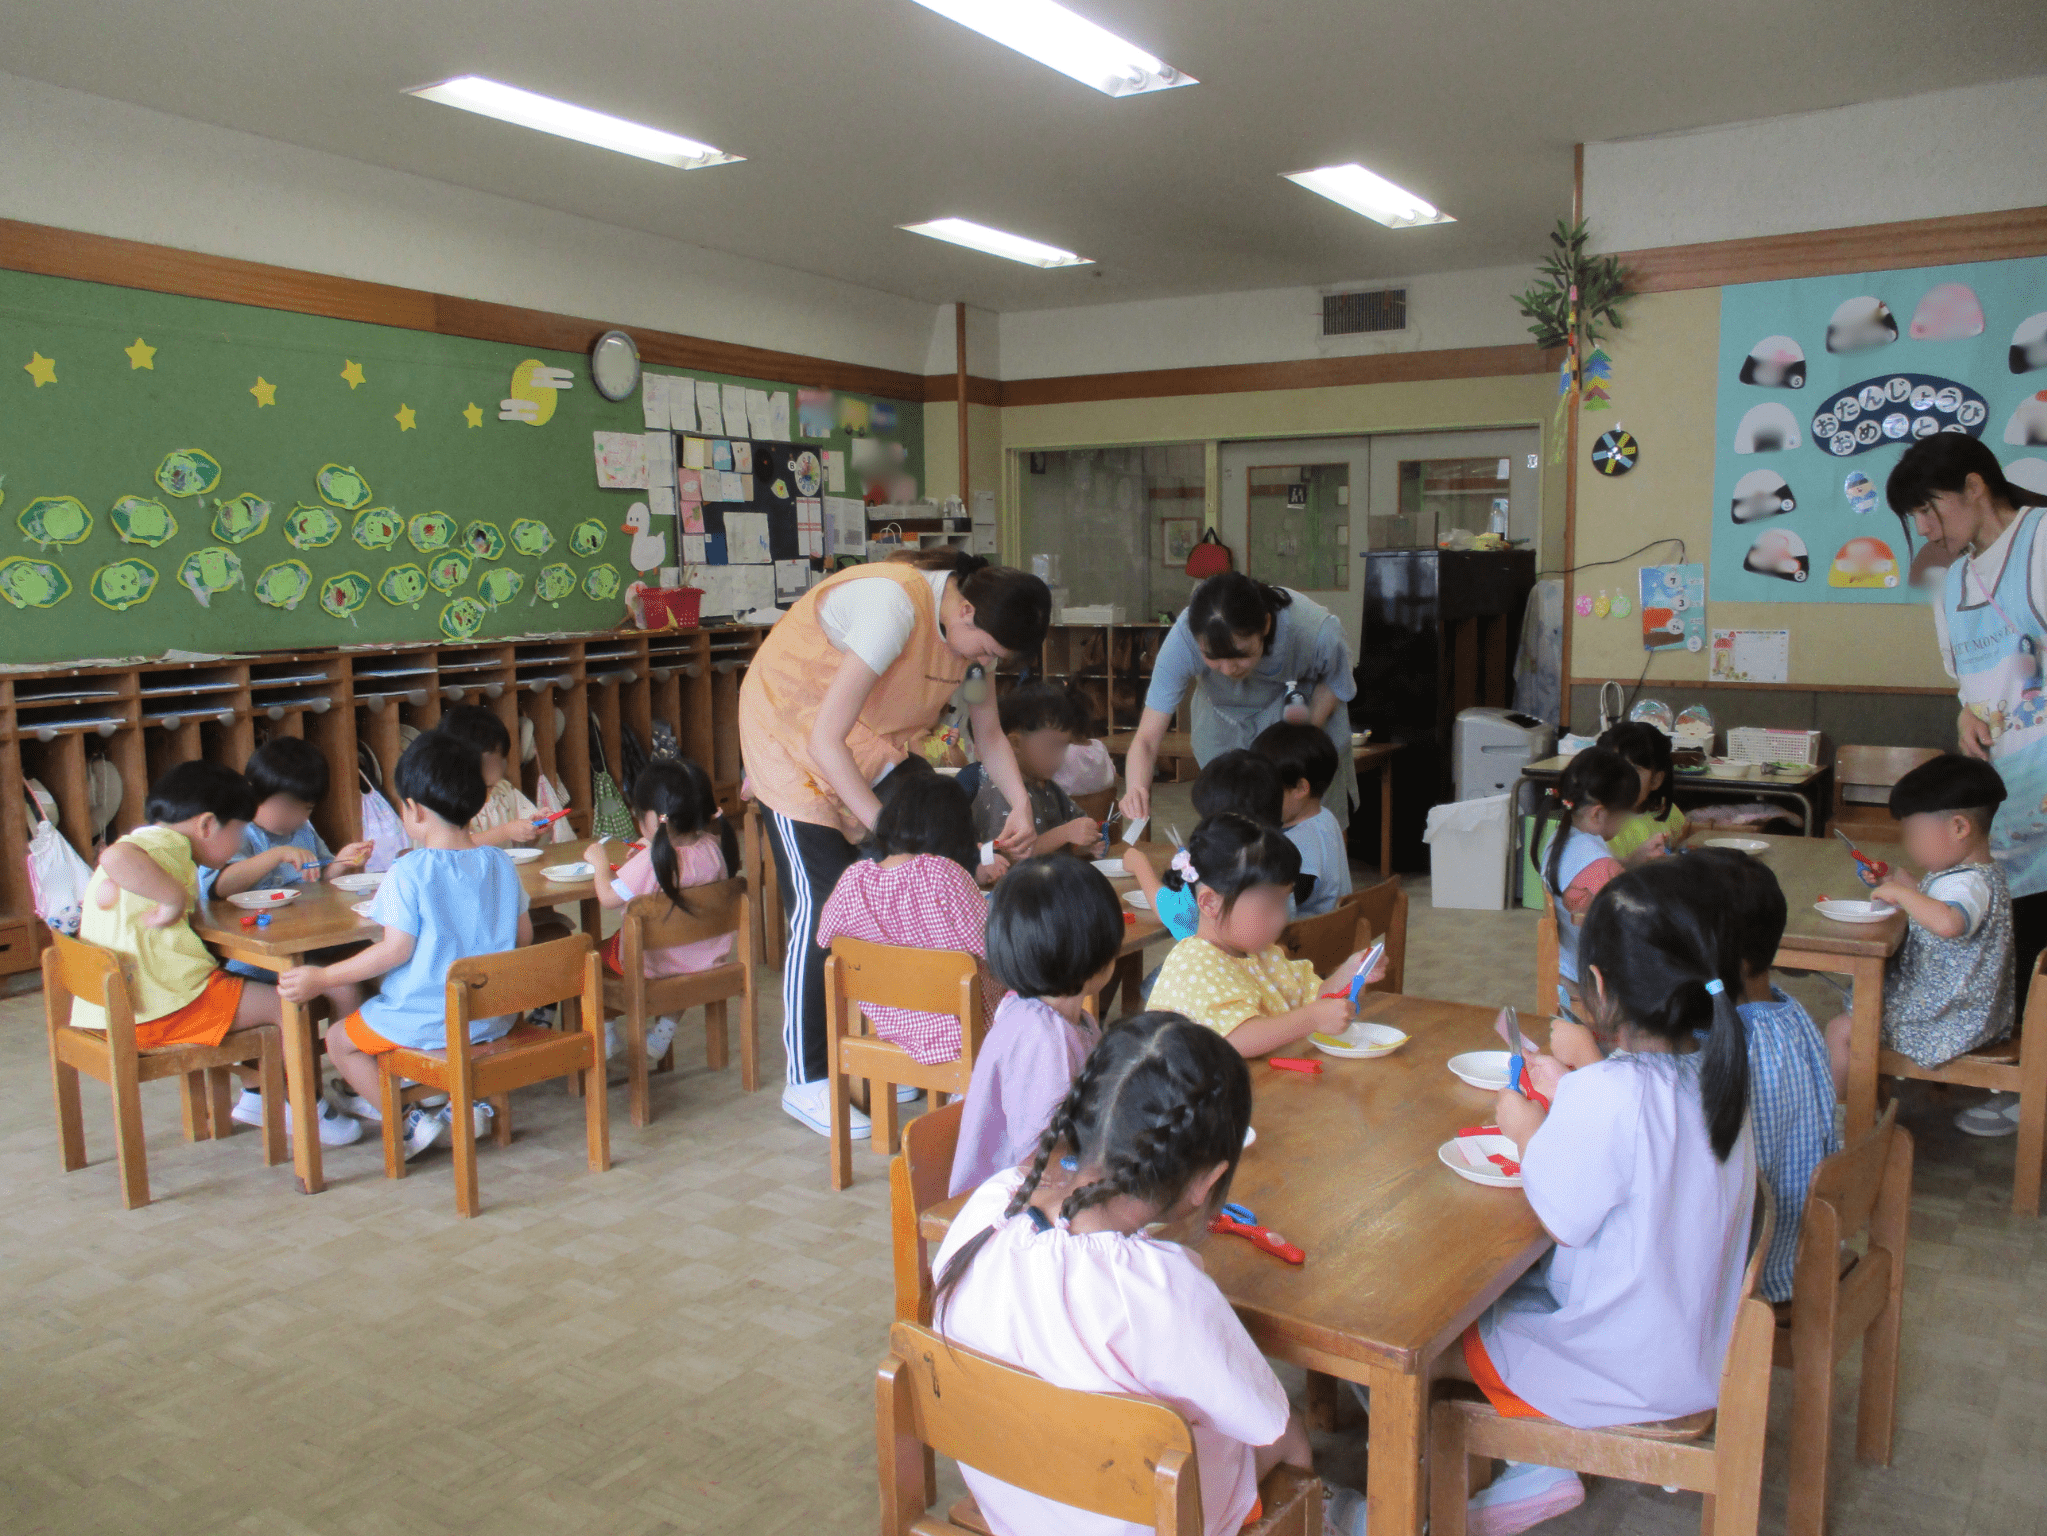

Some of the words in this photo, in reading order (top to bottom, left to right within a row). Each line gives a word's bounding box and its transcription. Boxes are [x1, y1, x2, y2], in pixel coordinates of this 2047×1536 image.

[1815, 380, 1983, 437] おたんじょうび
[1832, 416, 1963, 453] おめでと
